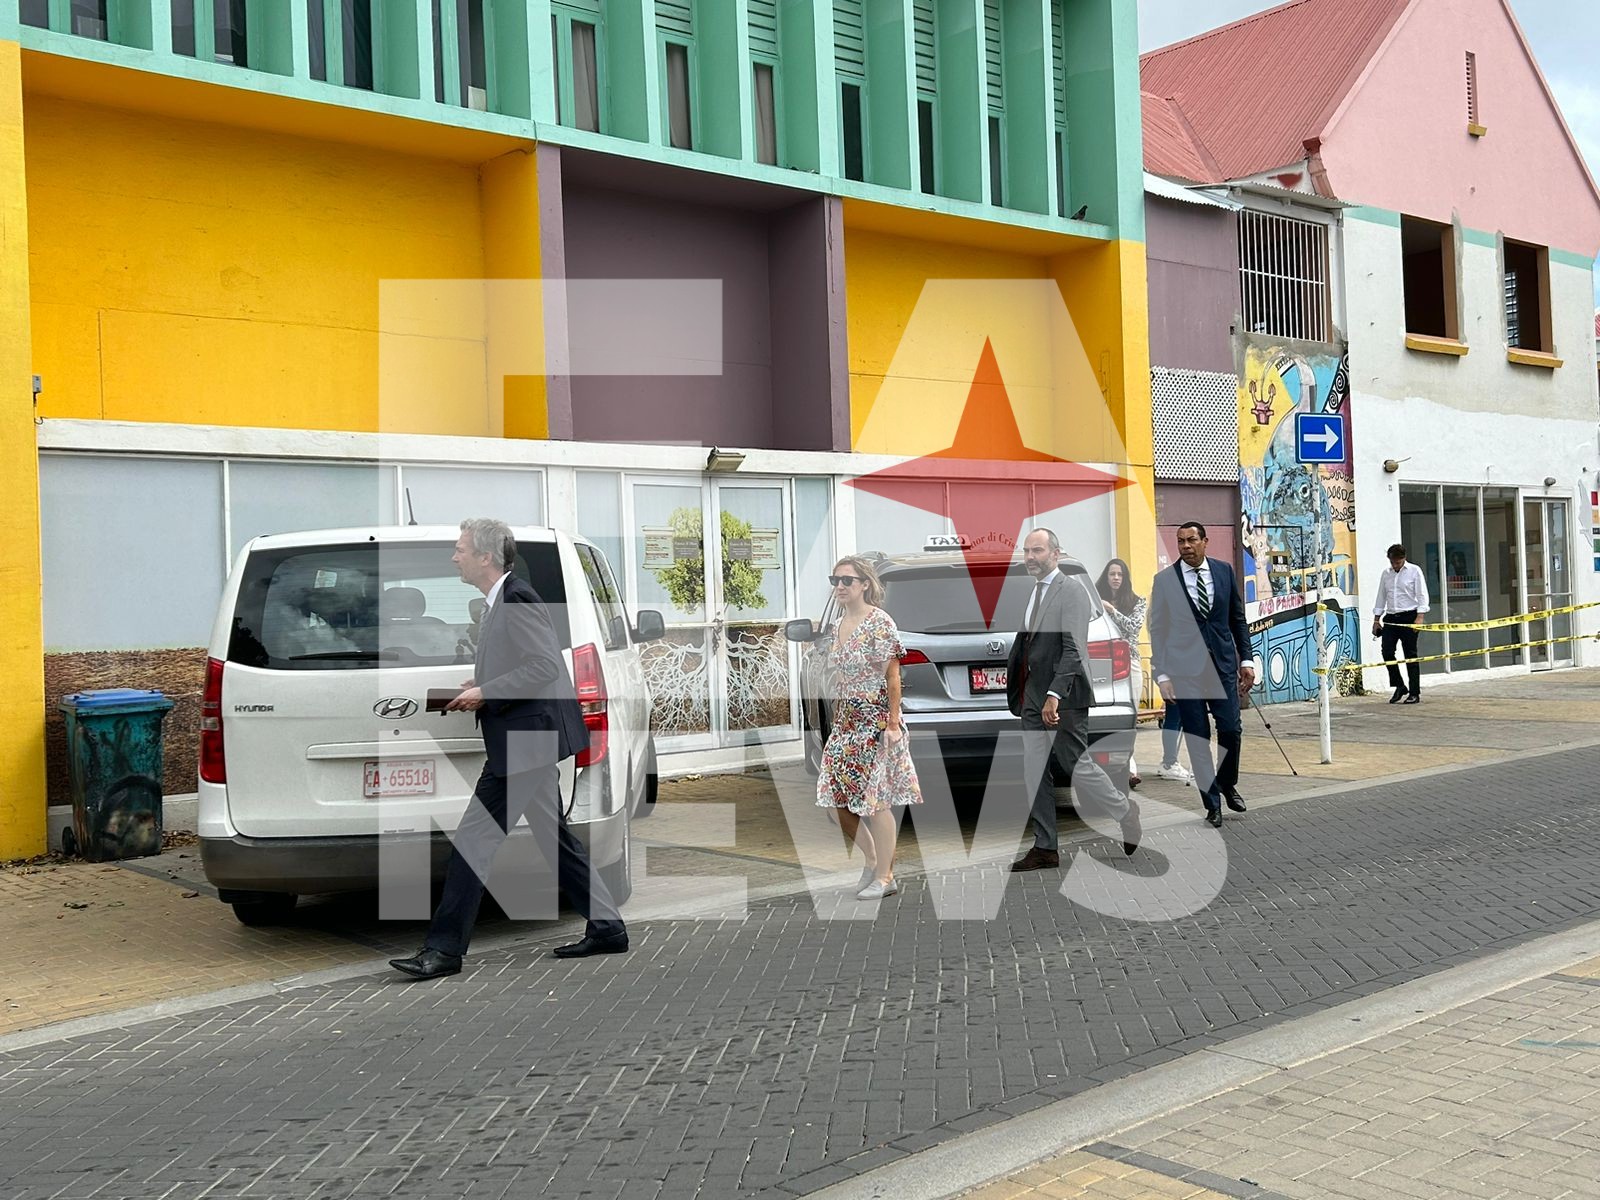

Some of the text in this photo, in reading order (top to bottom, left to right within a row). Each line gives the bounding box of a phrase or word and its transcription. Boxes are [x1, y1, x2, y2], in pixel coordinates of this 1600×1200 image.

[930, 536, 966, 545] TAXI
[987, 531, 996, 542] di
[999, 533, 1018, 549] Cris
